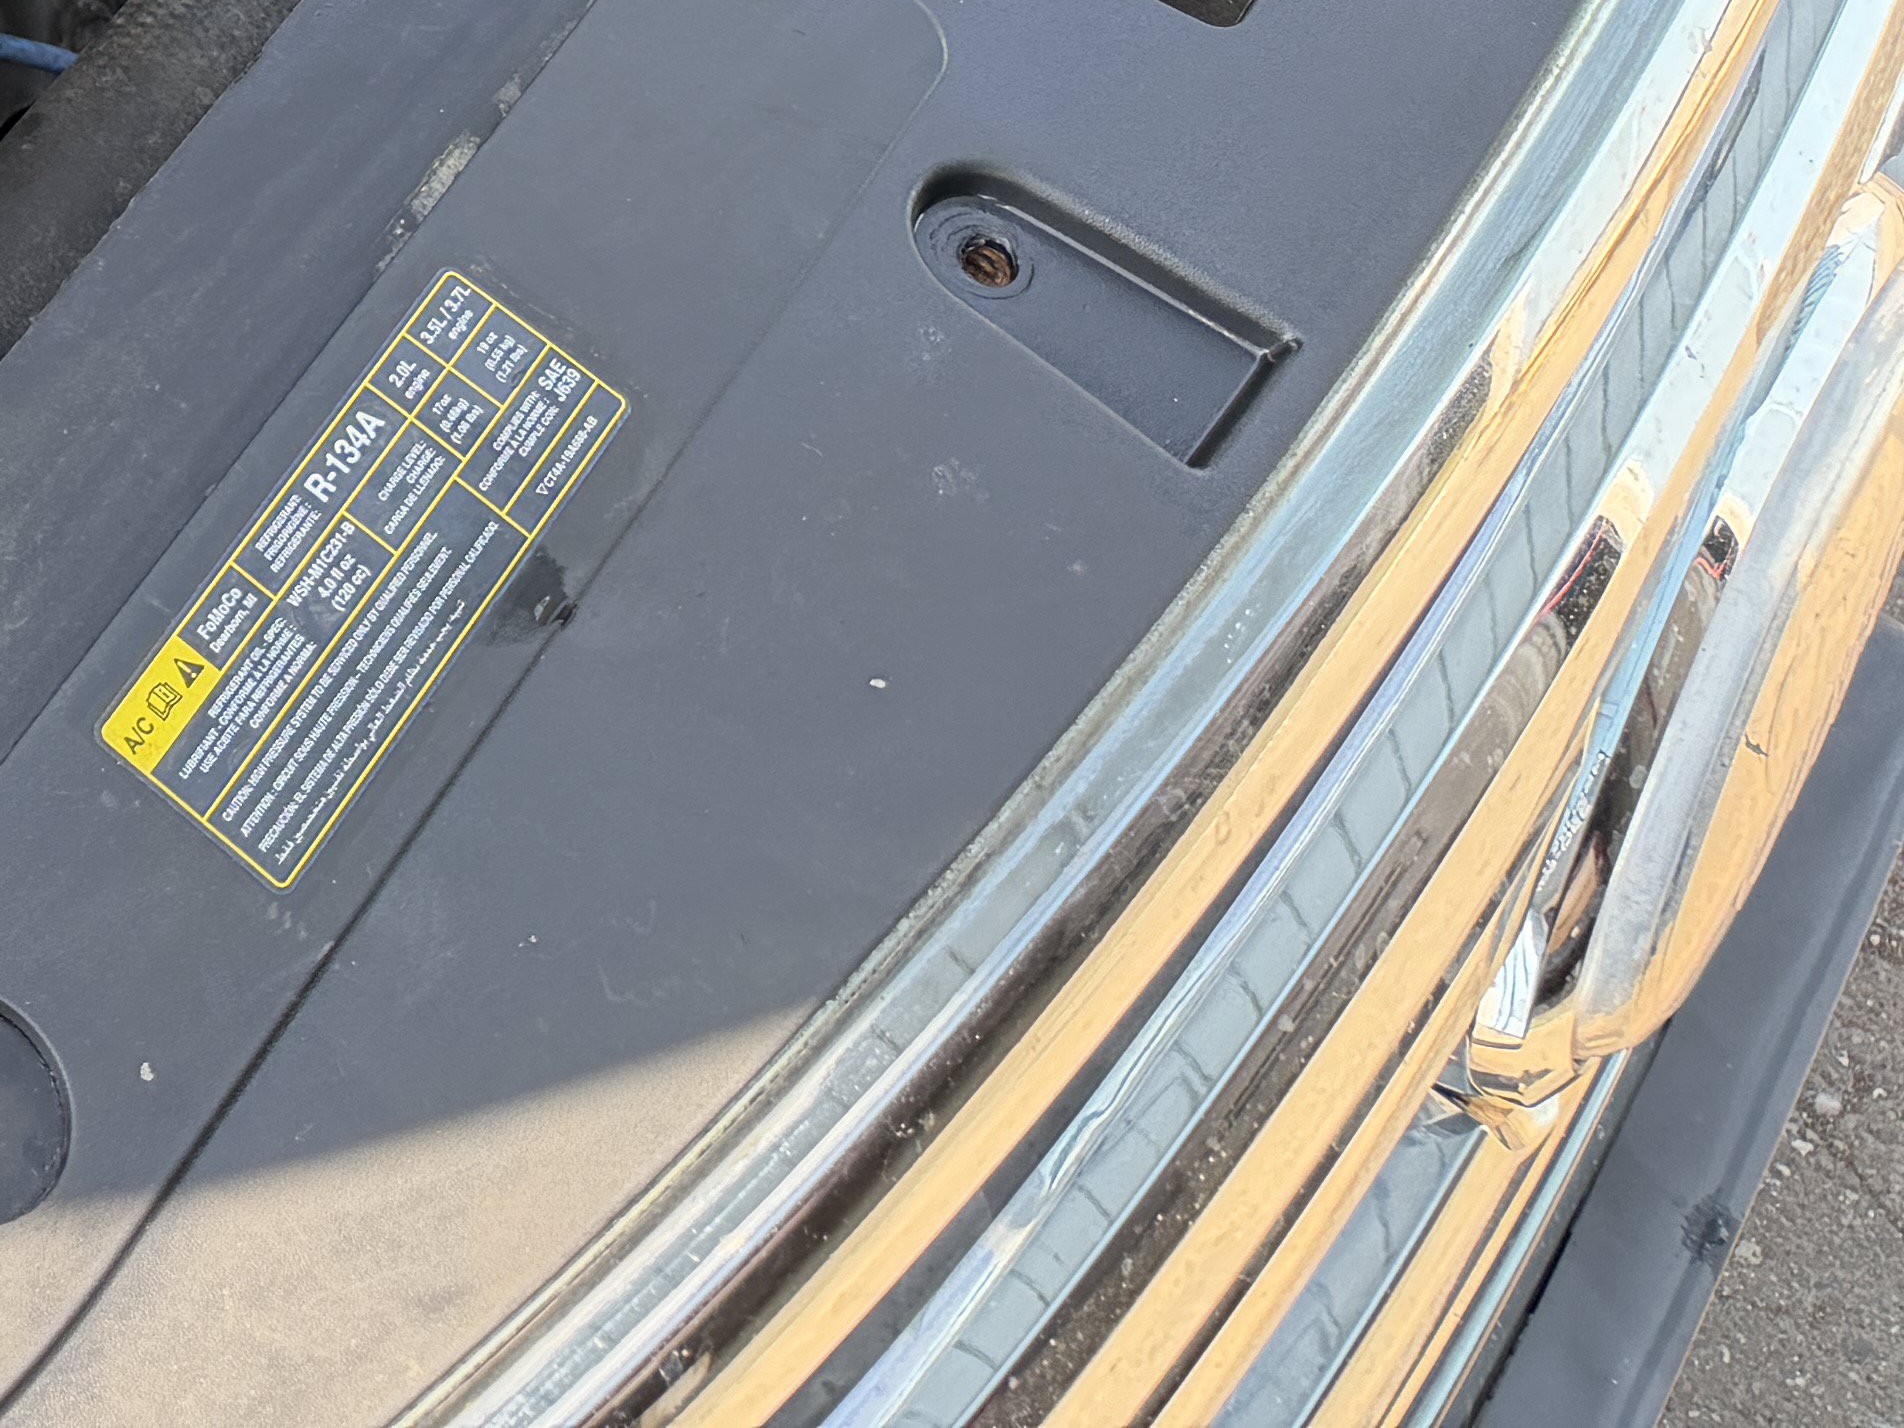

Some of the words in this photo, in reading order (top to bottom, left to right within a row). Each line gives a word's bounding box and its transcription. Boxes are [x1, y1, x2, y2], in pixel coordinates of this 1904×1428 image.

[418, 312, 449, 346] 3.5L
[443, 281, 472, 313] 3.7L
[445, 307, 476, 341] engine
[386, 355, 418, 389] 2.0L
[403, 366, 433, 401] engine
[494, 359, 516, 383] (1.21
[536, 356, 568, 392] SAE
[550, 366, 582, 402] J639
[302, 404, 387, 504] R-134A
[377, 465, 407, 502] CHARGE
[401, 438, 427, 470] LEVEL:
[404, 445, 437, 485] CHARGE:
[382, 502, 410, 535] CARGA
[403, 490, 419, 507] DE
[286, 519, 357, 609] WSH-M1C231-B
[315, 573, 338, 599] 4.0
[329, 565, 344, 579] fl
[338, 552, 355, 571] oz
[329, 581, 358, 613] (120
[348, 562, 372, 588] cc)
[196, 583, 243, 640] FoMoCo
[208, 604, 249, 654] Dearborn,
[242, 592, 258, 609] MI
[198, 751, 218, 774] USE
[212, 721, 240, 755] ACEITE
[234, 698, 256, 725] PARA
[250, 632, 305, 703] REFRIGERANTES
[207, 658, 255, 719] REFRIGERANT
[248, 679, 288, 729] CONFORME
[310, 683, 324, 698] TO
[120, 714, 156, 755] A/C
[178, 727, 220, 780] LUBRIFIANT
[217, 676, 257, 726] CONFORME
[257, 657, 272, 672] LA
[307, 711, 332, 741] HAUTE
